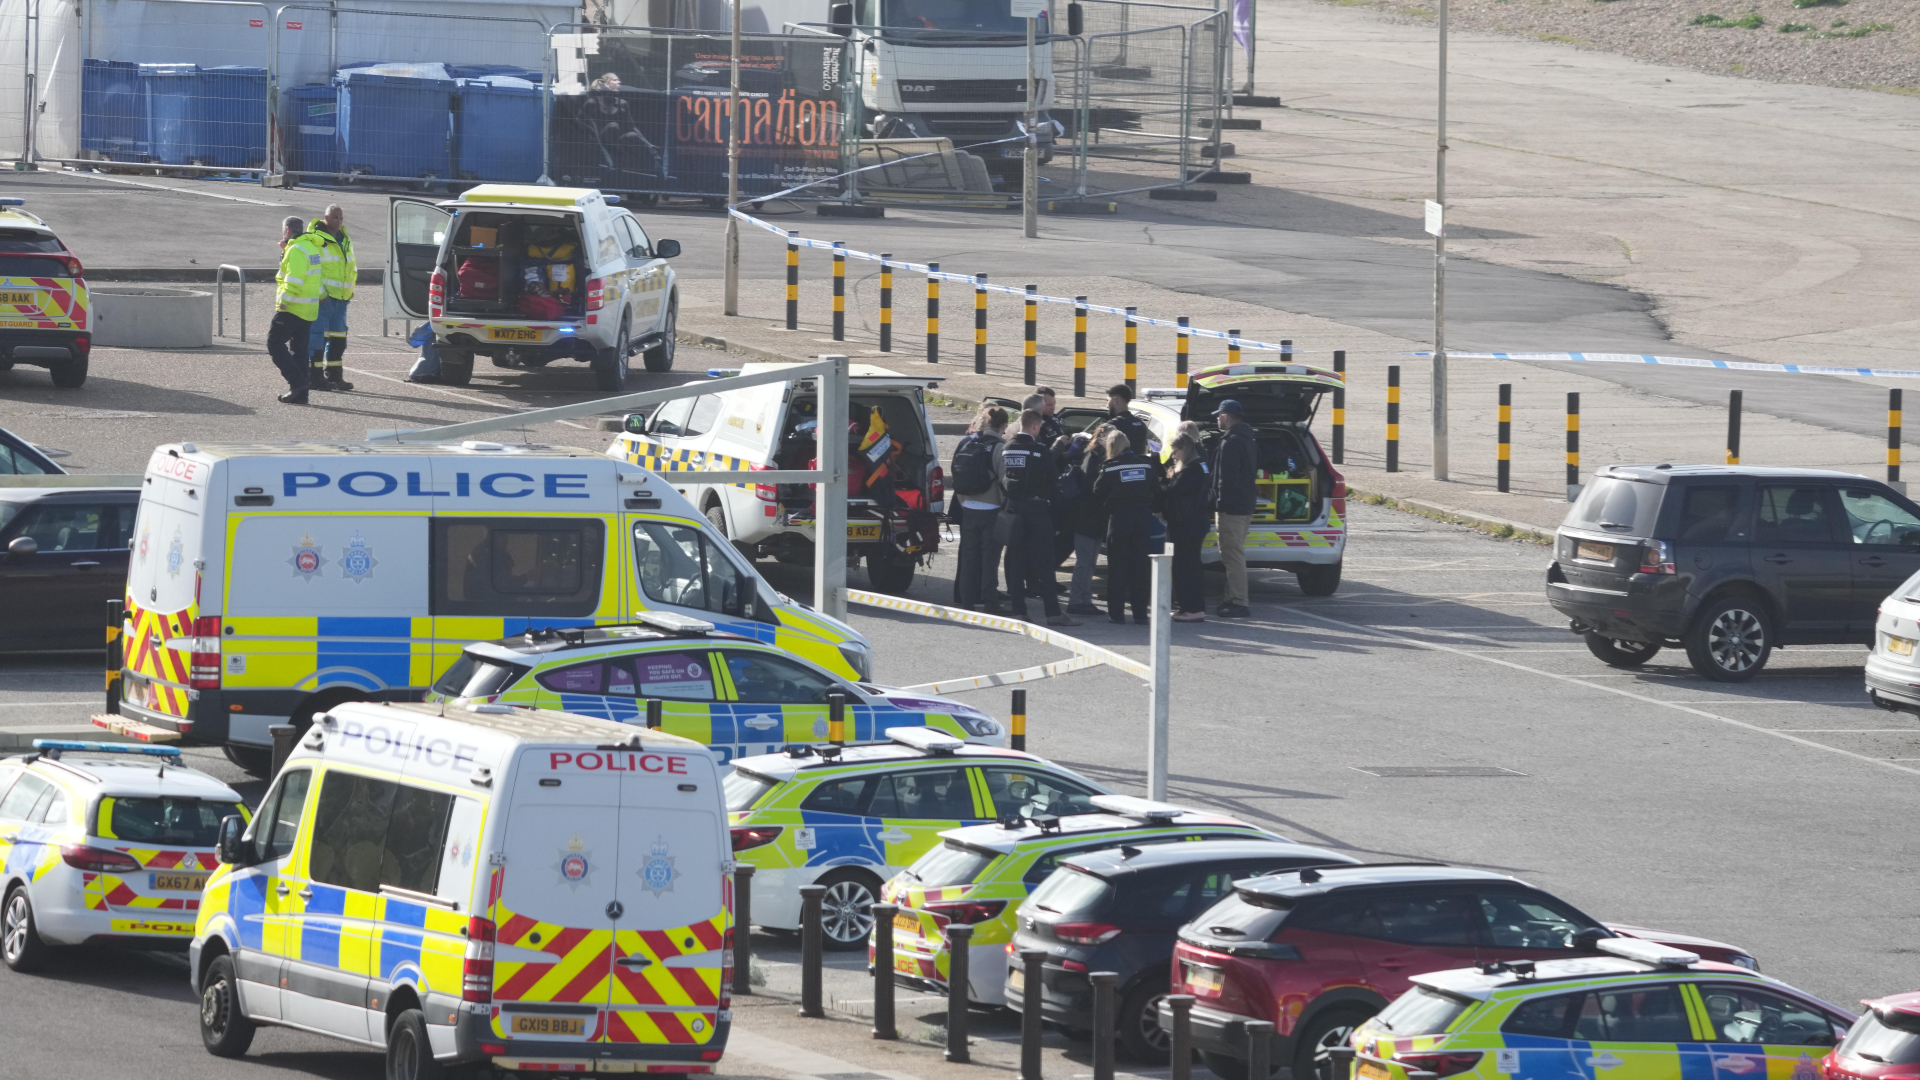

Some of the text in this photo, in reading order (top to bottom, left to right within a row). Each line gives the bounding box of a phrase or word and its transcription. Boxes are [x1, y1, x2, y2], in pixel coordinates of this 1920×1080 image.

[12, 294, 30, 302] AAK
[494, 329, 536, 339] WX17 EHG
[1005, 456, 1025, 466] POLICE
[152, 459, 196, 480] POLICE
[282, 471, 590, 498] POLICE
[856, 527, 875, 536] ABZ
[339, 718, 479, 774] POLICE
[550, 752, 688, 774] POLICE
[157, 876, 190, 888] GX67
[130, 924, 195, 932] POL
[520, 1018, 576, 1033] GX19 BBJ
